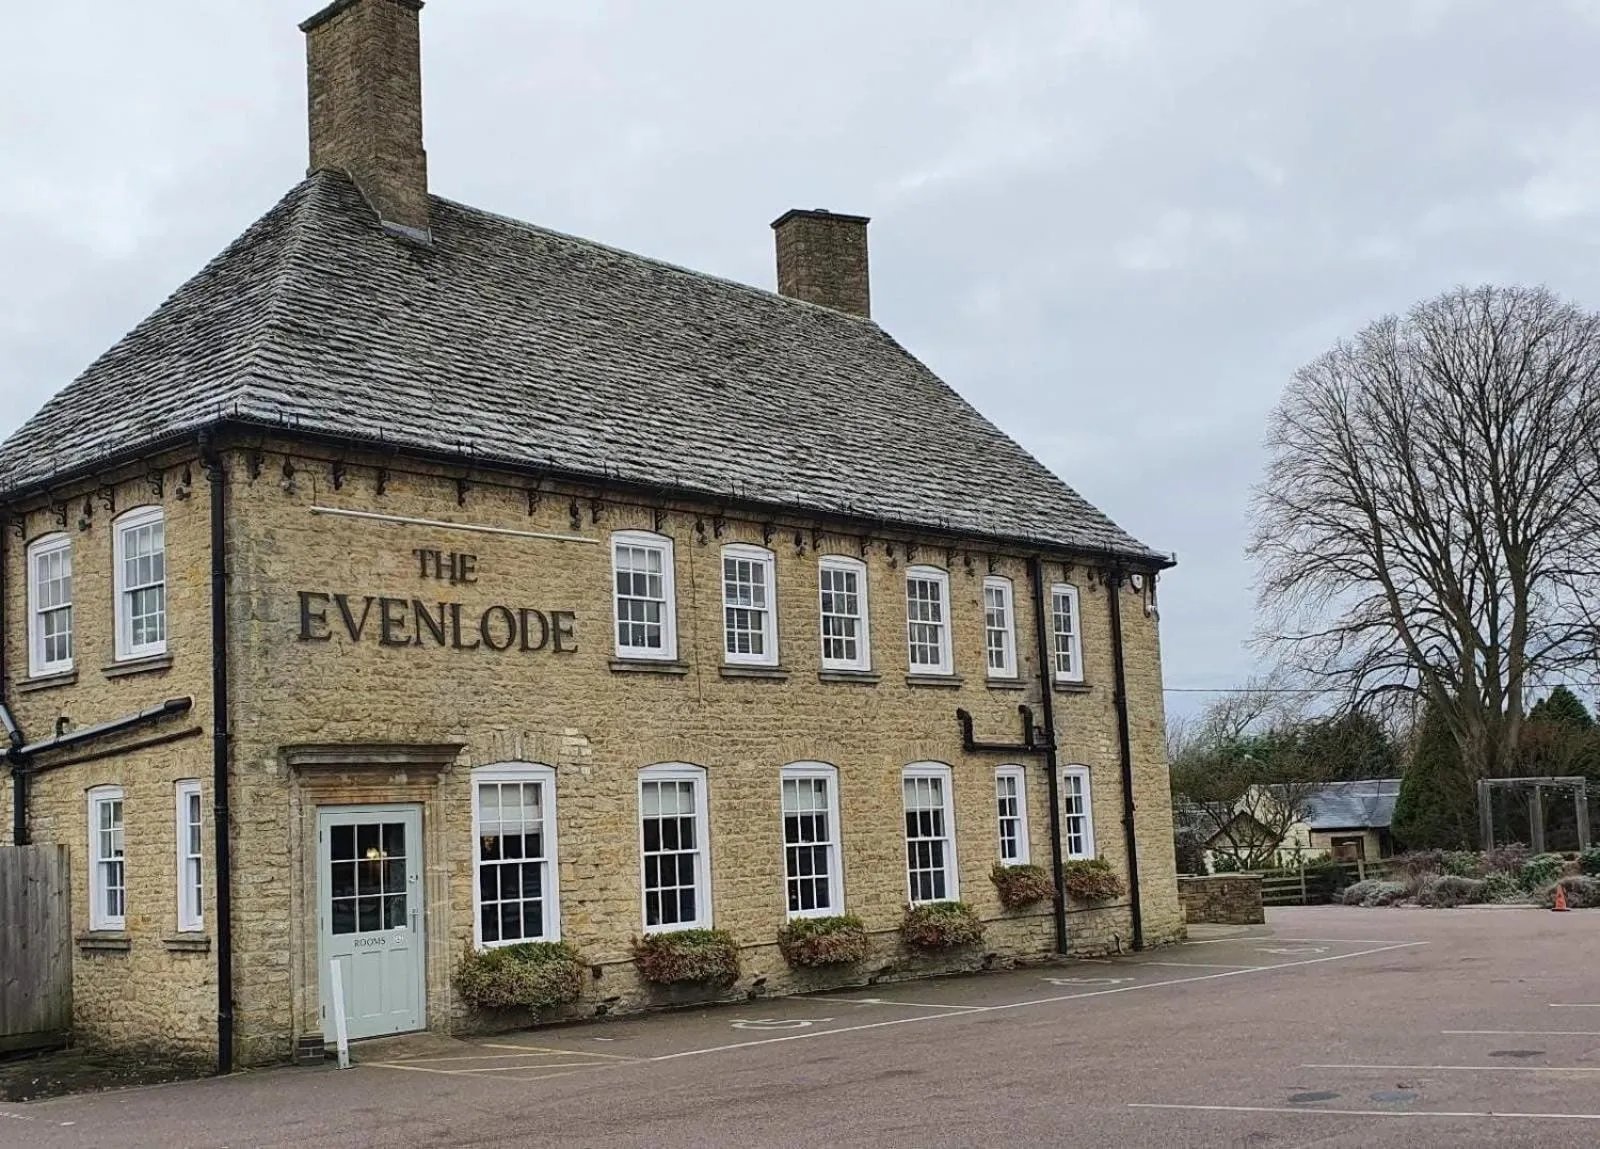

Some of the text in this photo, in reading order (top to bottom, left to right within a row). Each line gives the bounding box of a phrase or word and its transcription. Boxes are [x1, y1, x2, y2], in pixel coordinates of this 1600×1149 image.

[412, 549, 478, 584] THE
[297, 590, 579, 653] EVENLODE
[353, 937, 386, 948] ROOMS
